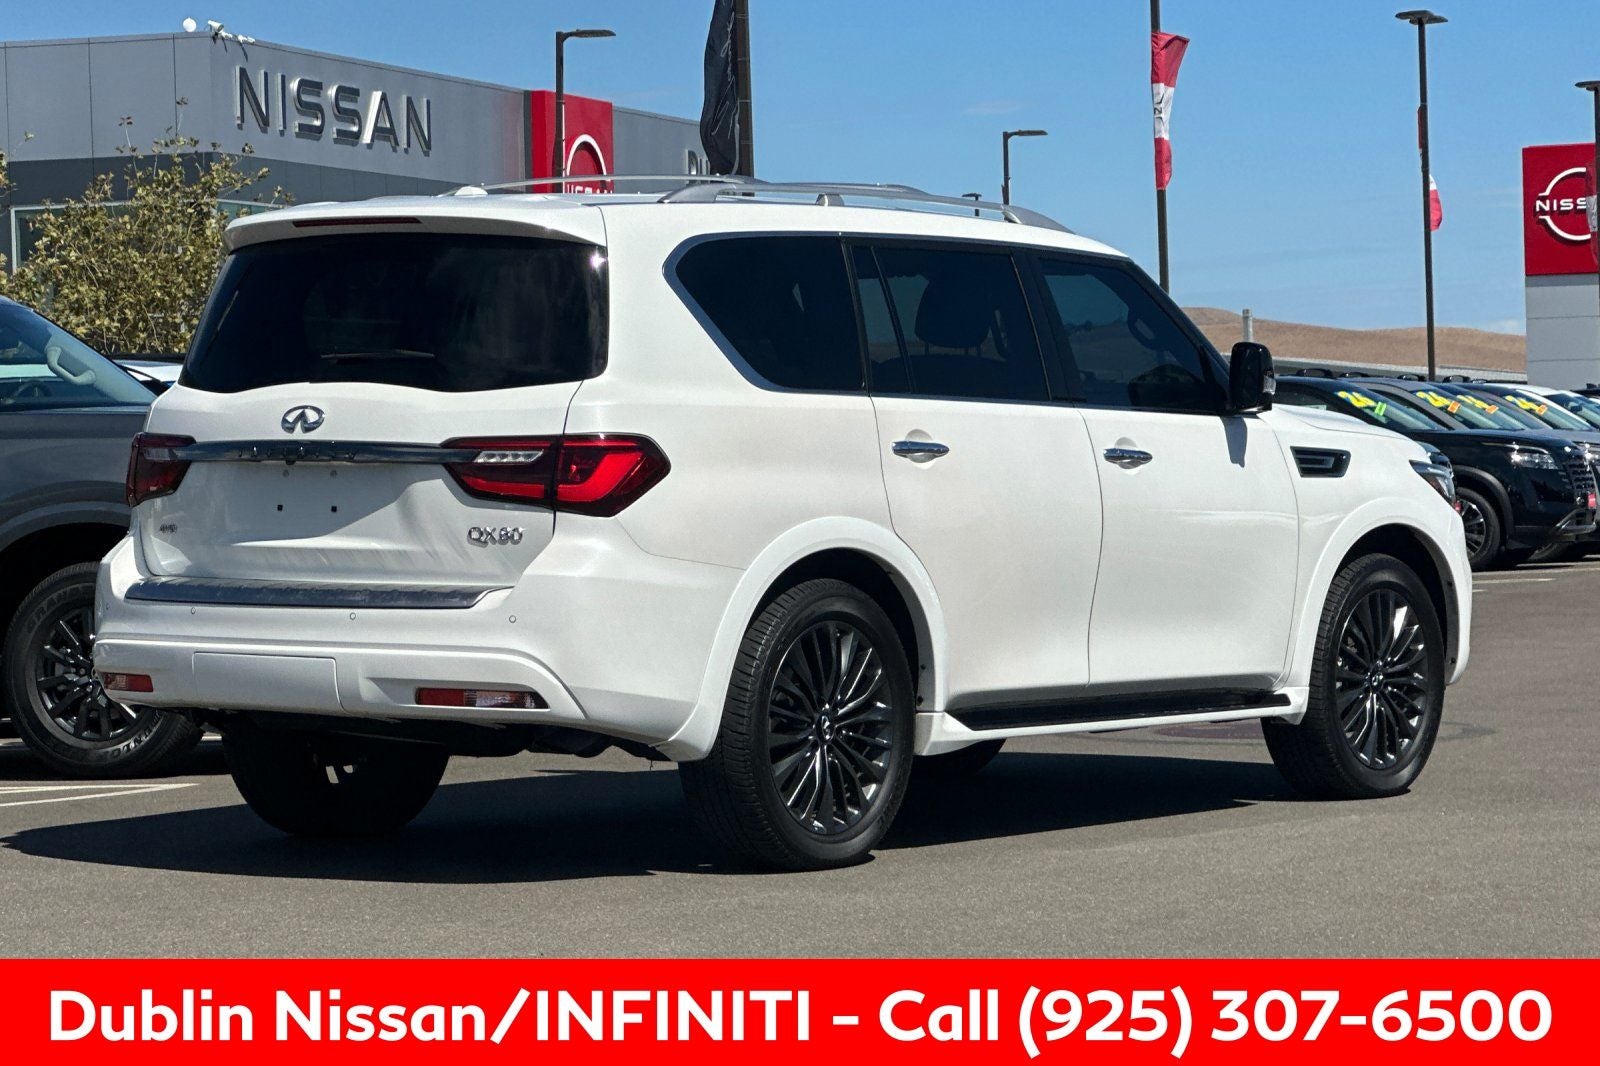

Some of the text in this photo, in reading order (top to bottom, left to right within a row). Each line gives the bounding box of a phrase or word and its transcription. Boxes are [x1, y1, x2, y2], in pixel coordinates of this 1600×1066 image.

[235, 65, 431, 157] NISSAN
[1535, 197, 1587, 212] NISS
[467, 526, 523, 547] QX80
